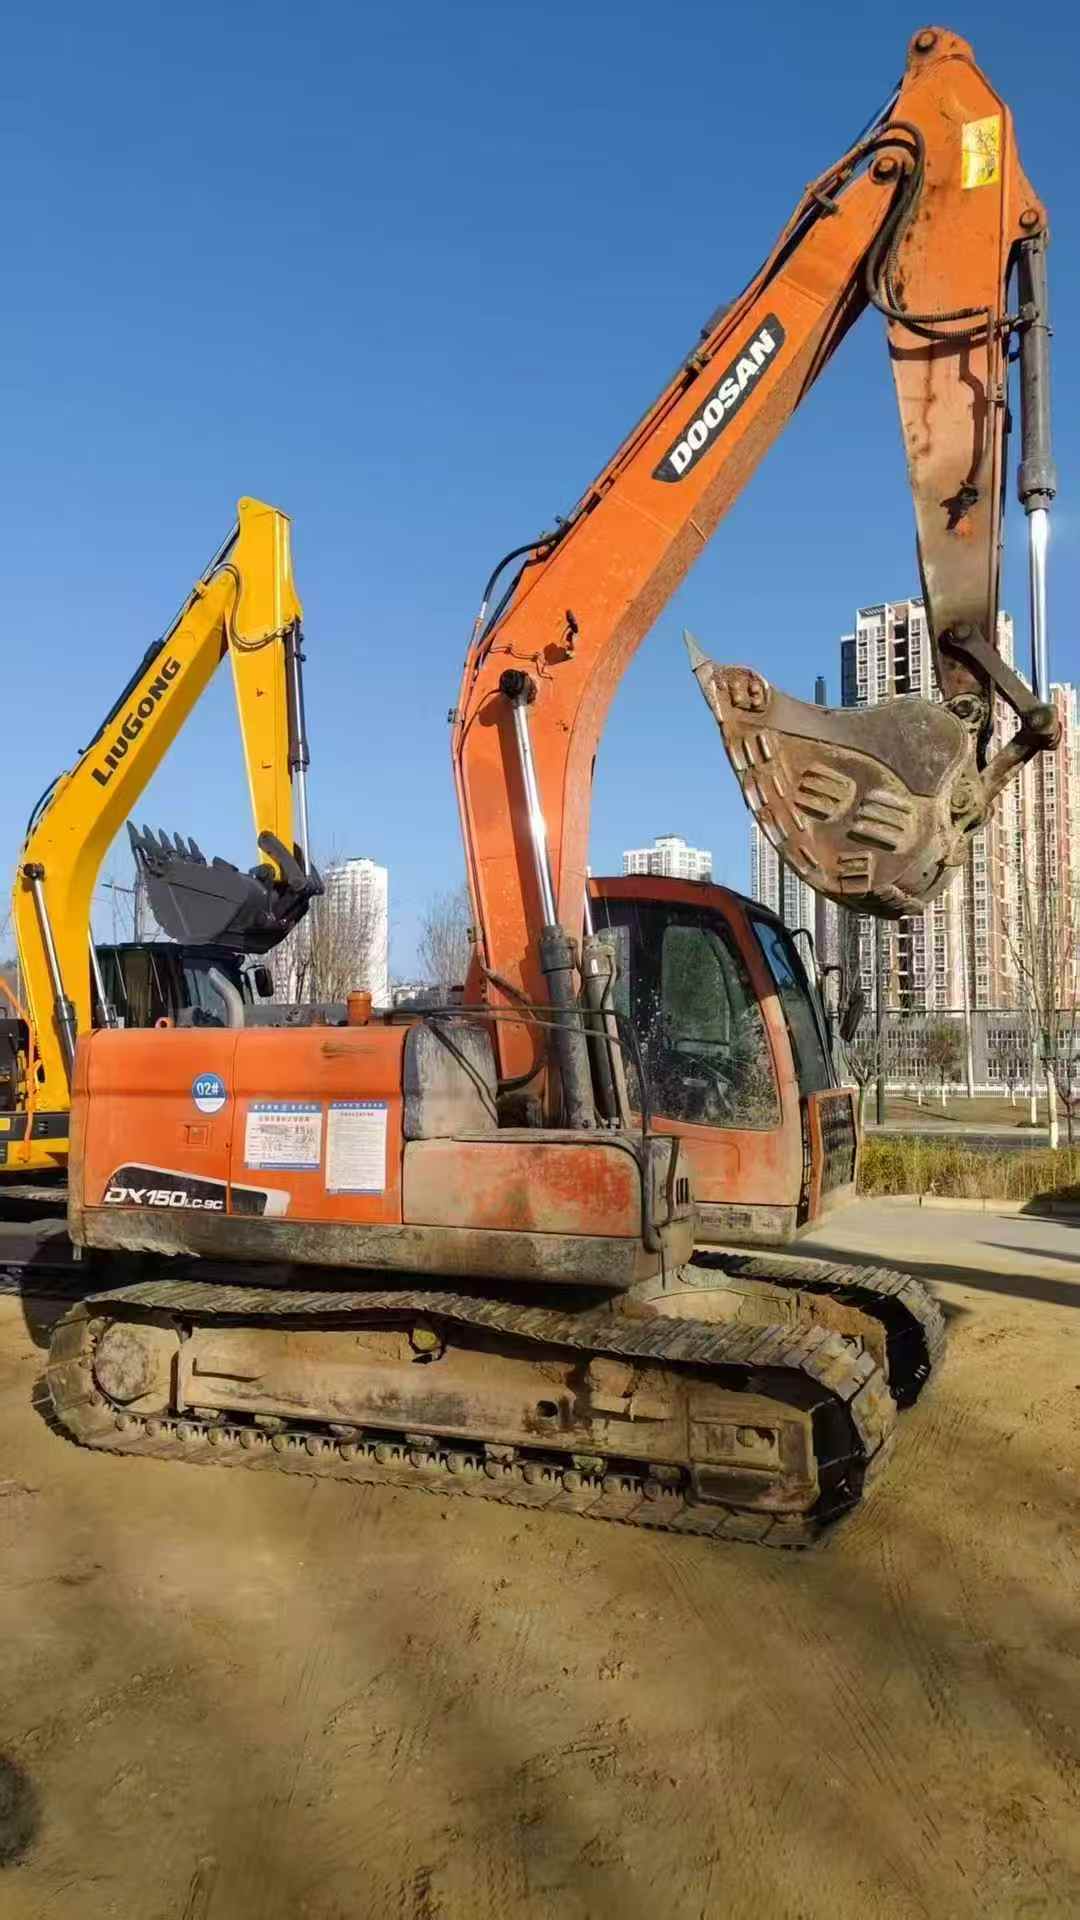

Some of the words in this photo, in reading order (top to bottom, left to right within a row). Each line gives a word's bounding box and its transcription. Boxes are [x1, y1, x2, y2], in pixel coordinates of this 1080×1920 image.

[669, 328, 775, 474] DOOSAN
[91, 656, 181, 786] LIUGONG
[196, 1081, 219, 1096] 02#
